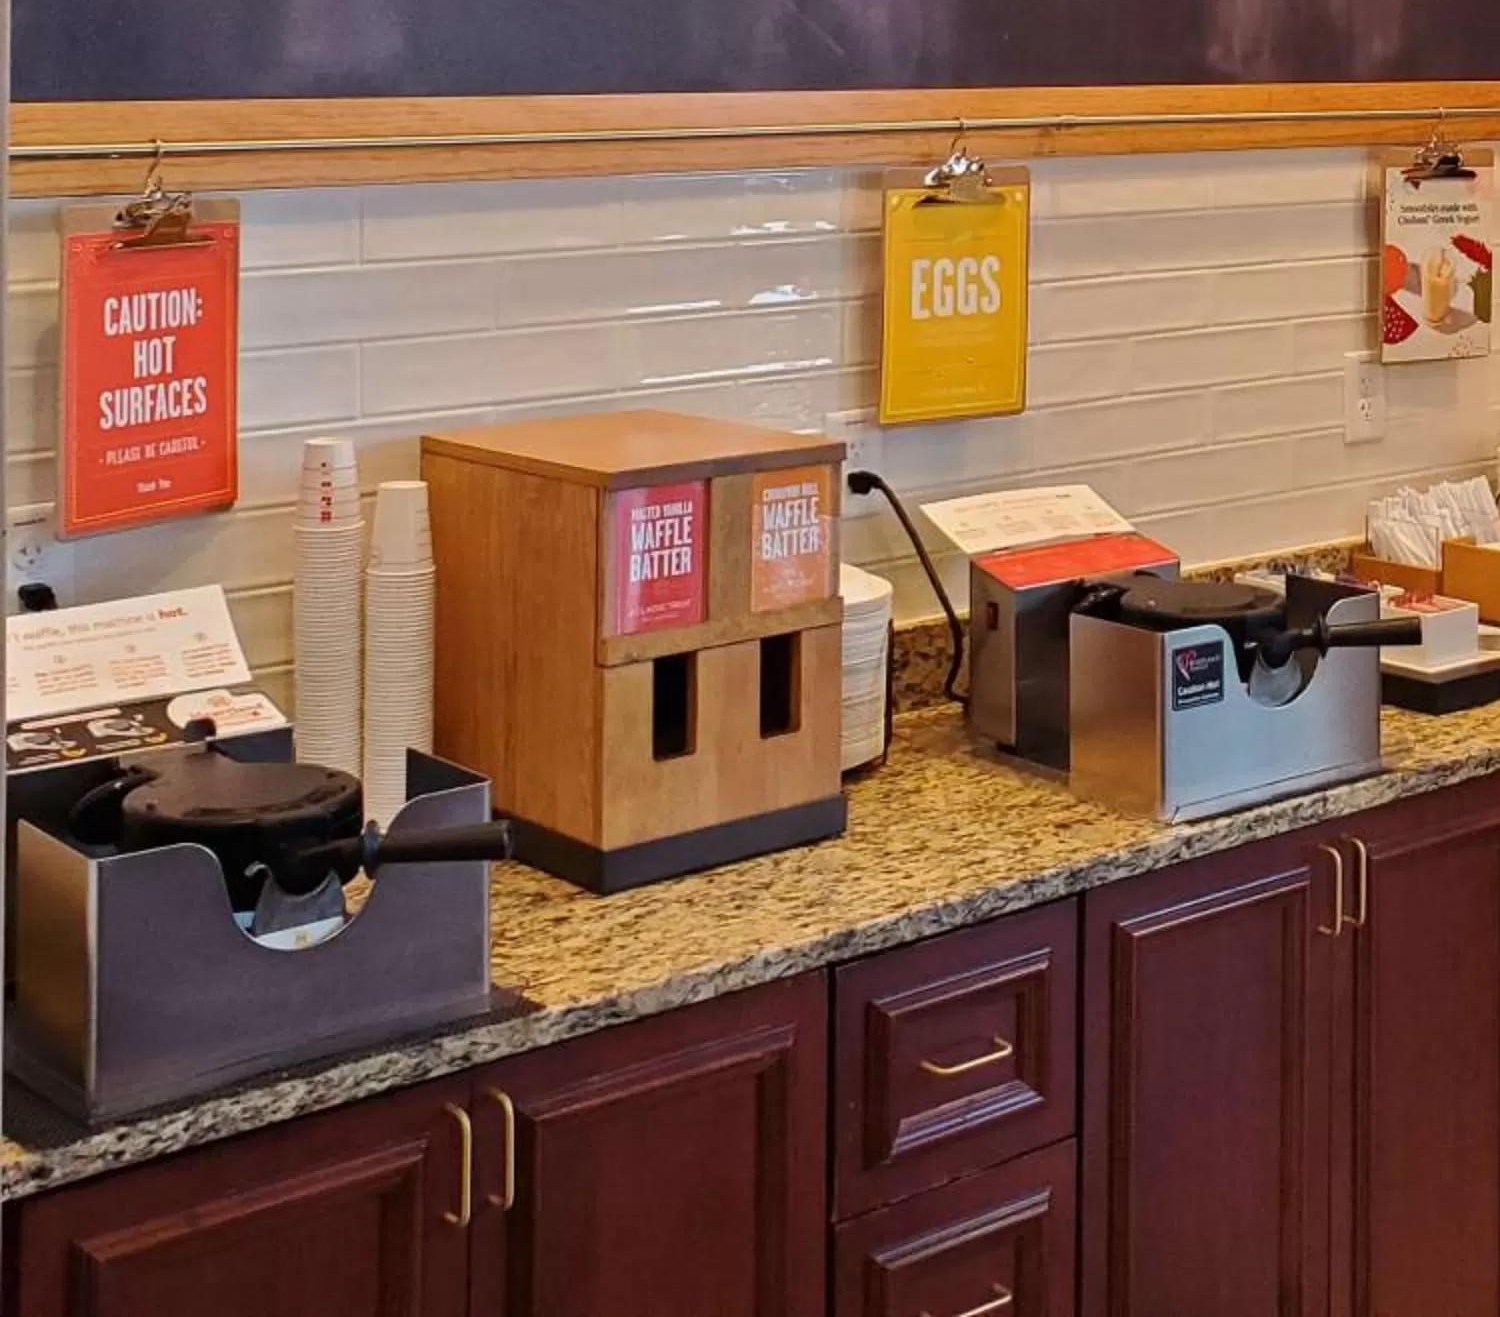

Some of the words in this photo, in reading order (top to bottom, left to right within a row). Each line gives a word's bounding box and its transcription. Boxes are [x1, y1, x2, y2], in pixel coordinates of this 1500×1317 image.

[911, 255, 1001, 320] EGGS
[103, 287, 203, 336] CAUTION:
[133, 336, 176, 380] HOT
[99, 376, 207, 431] SURFACES
[631, 515, 693, 551] WAFFLE
[763, 497, 820, 532] WAFFLE
[761, 524, 819, 561] BATTER
[629, 546, 692, 583] BATTER
[158, 606, 189, 619] hot.
